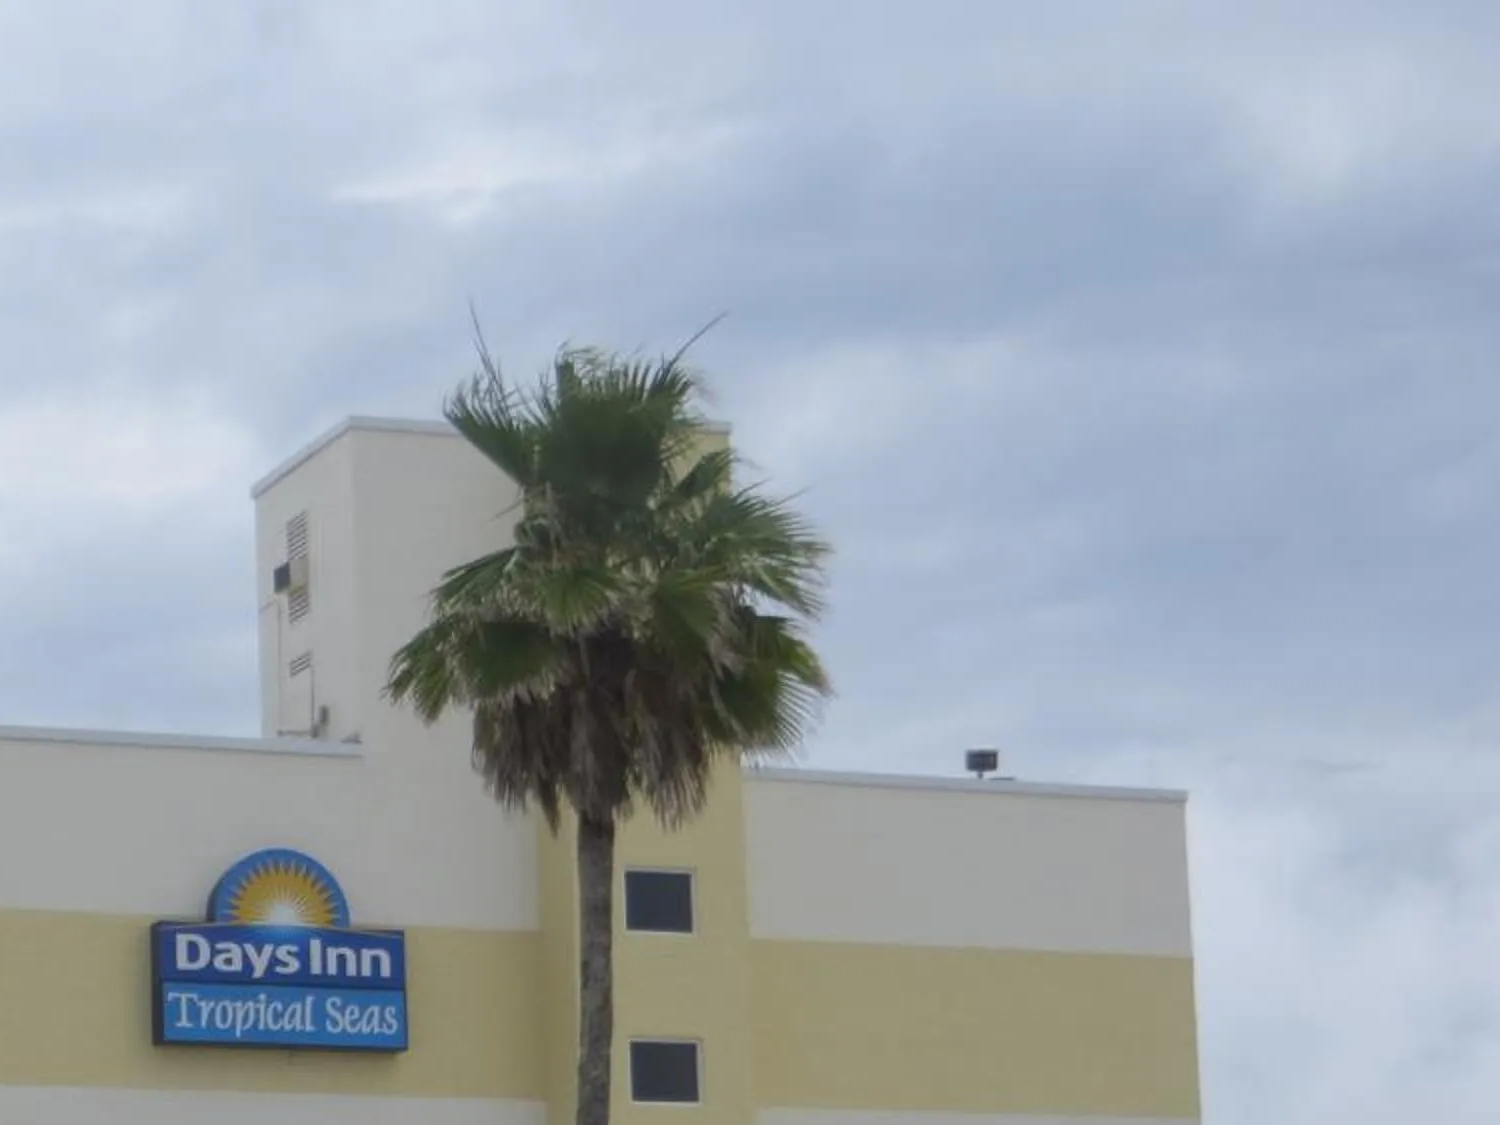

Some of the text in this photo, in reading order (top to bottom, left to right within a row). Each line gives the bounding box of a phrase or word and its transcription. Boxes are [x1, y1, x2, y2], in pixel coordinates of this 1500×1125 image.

[175, 932, 391, 978] Days Inn
[167, 991, 398, 1038] Tropical Seas
